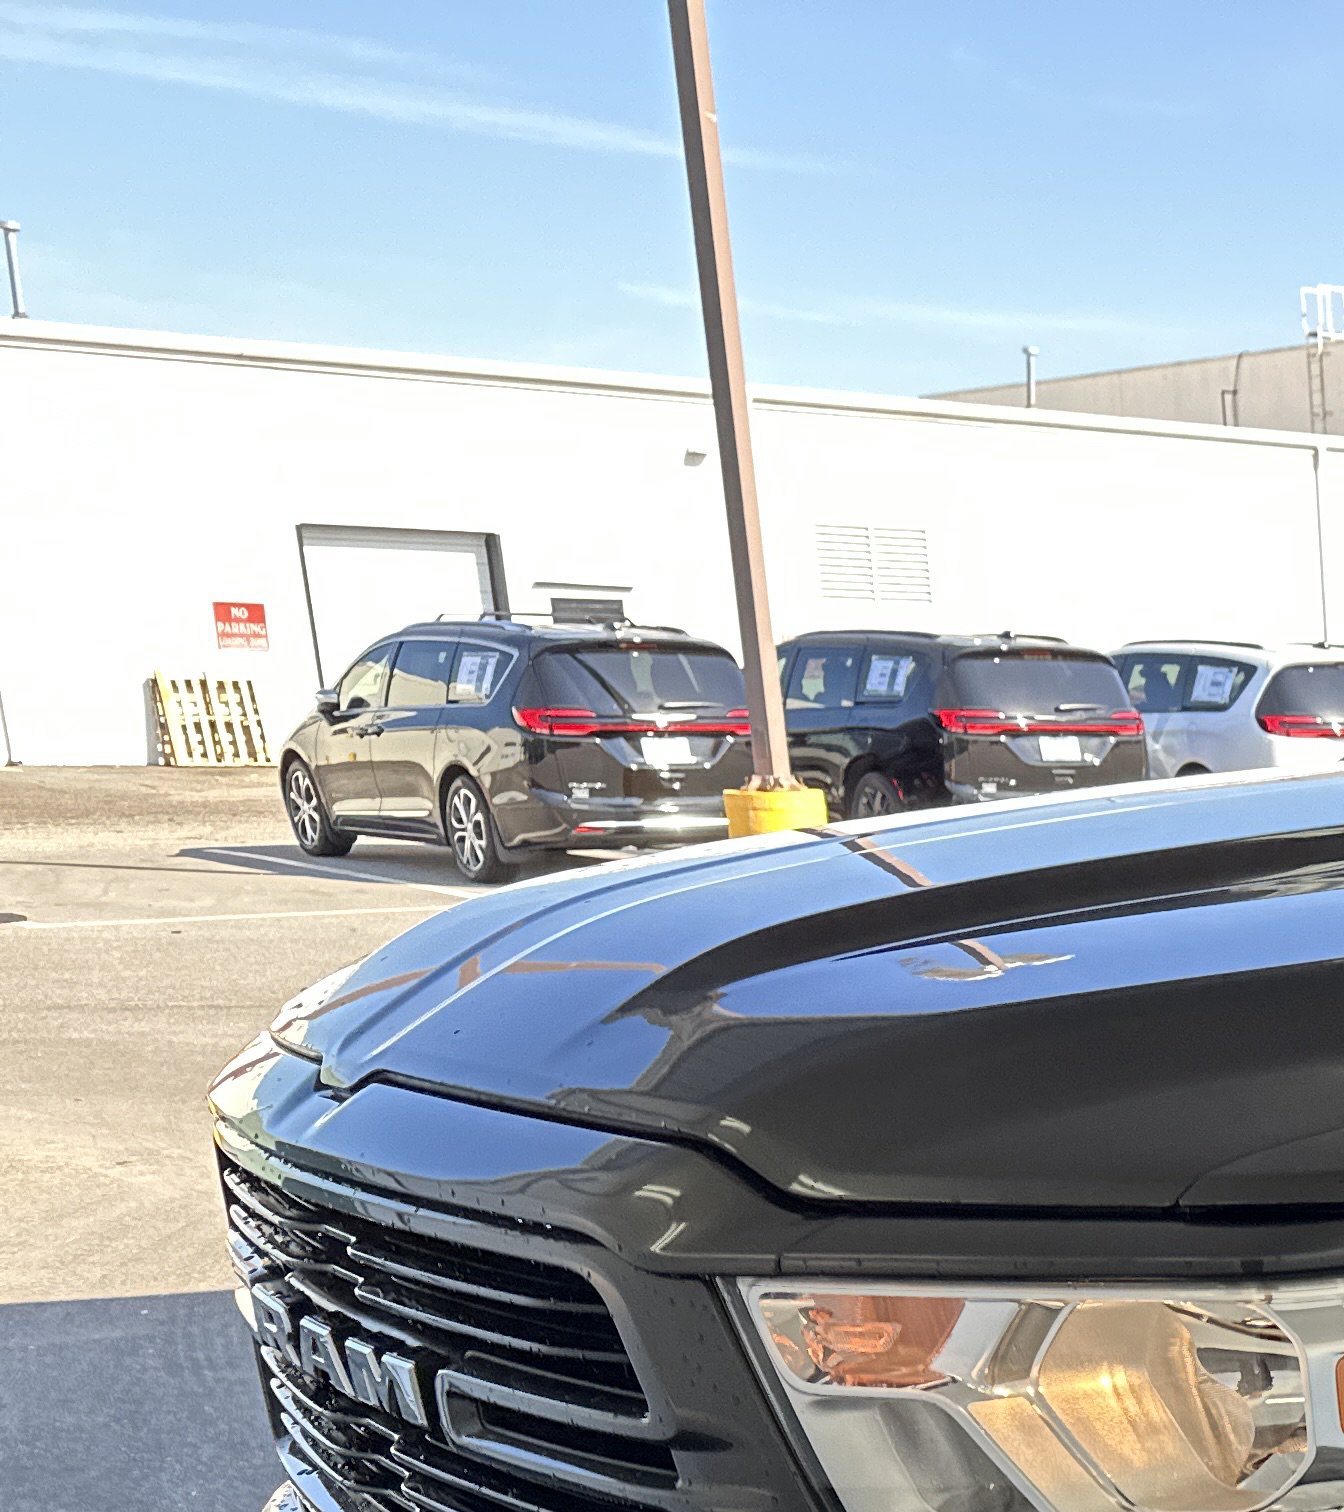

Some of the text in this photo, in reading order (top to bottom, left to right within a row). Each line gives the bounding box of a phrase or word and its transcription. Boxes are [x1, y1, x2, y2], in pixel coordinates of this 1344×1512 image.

[231, 606, 249, 619] NO
[217, 621, 267, 635] PARKING
[251, 1283, 429, 1430] RAM
